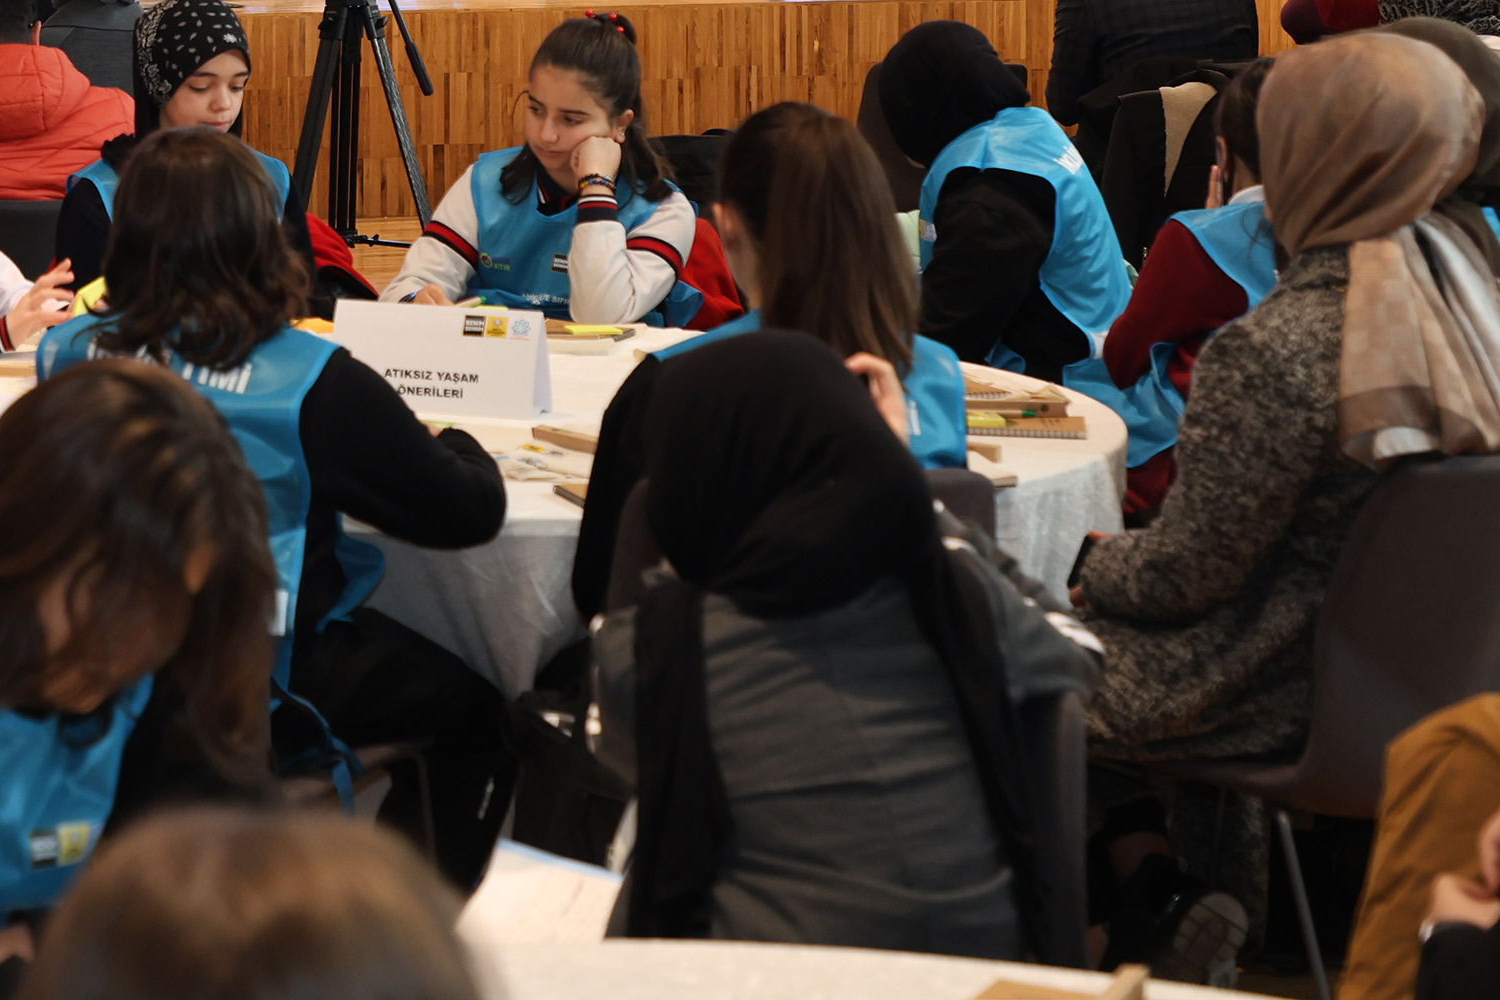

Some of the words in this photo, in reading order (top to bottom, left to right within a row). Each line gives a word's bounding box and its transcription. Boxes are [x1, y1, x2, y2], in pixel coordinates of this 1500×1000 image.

[384, 368, 433, 380] ATIKSIZ
[437, 371, 479, 384] YAŞAM
[397, 383, 464, 399] ÖNERİLERİ
